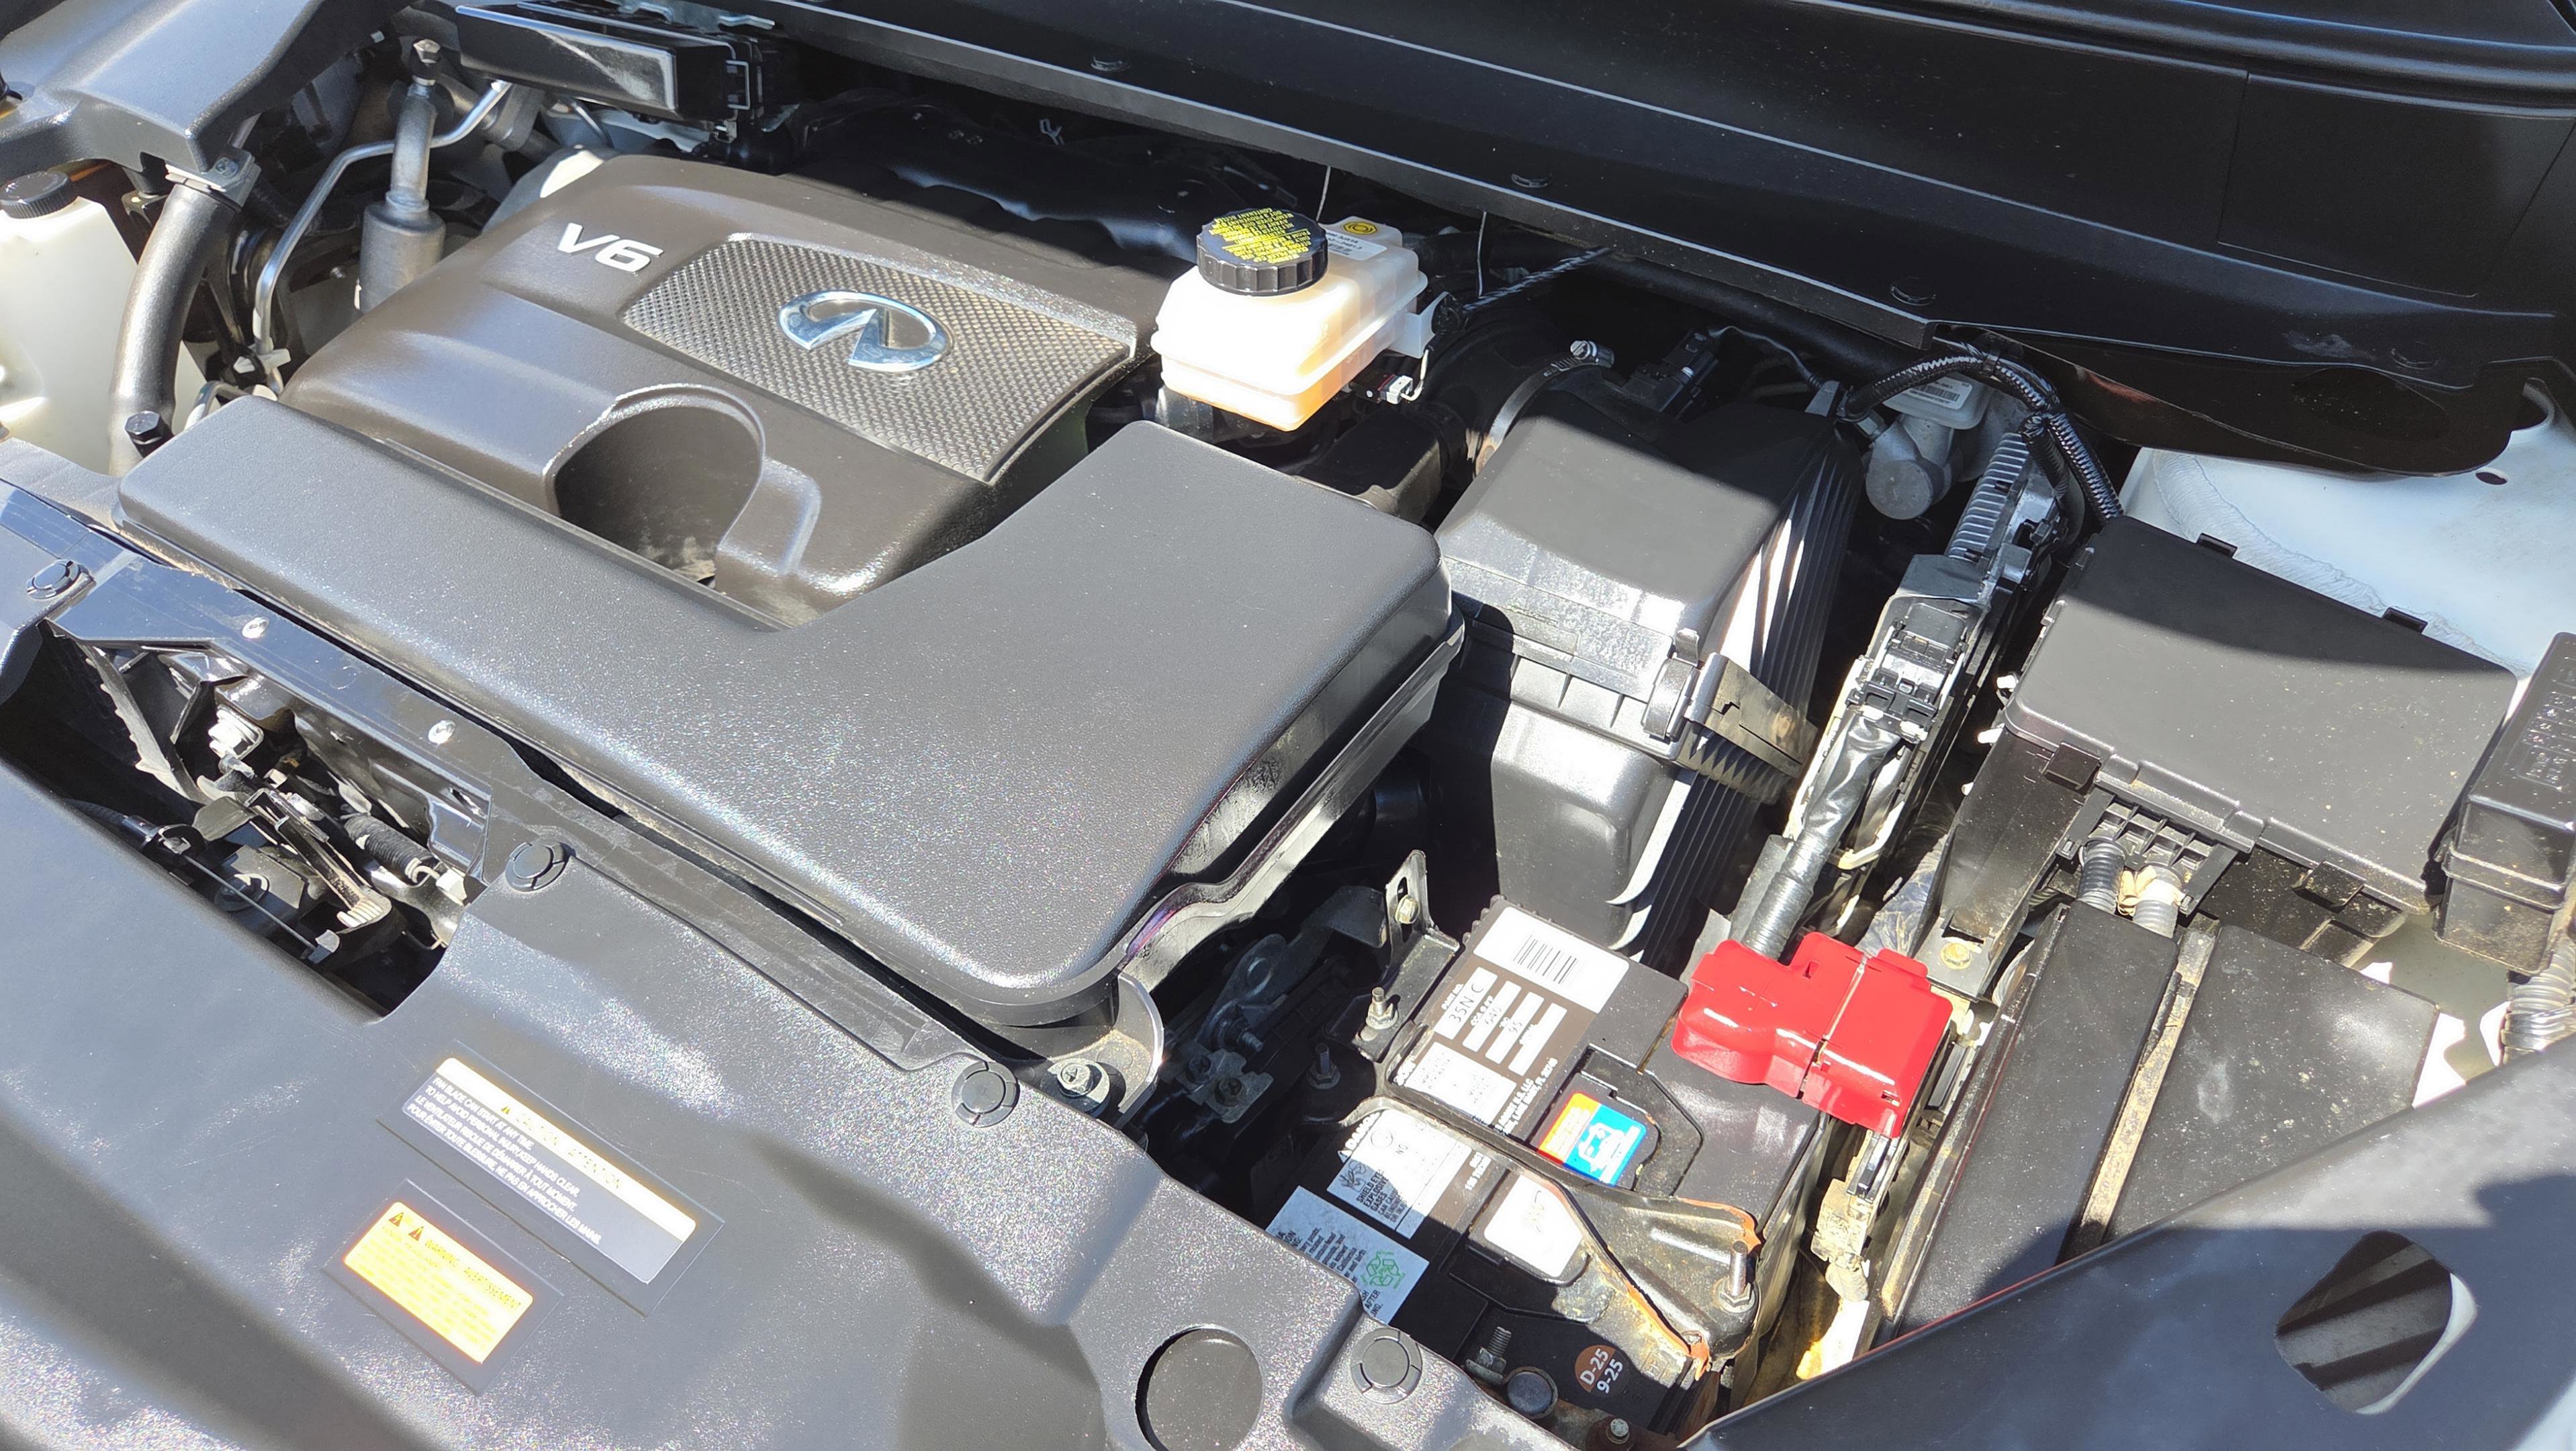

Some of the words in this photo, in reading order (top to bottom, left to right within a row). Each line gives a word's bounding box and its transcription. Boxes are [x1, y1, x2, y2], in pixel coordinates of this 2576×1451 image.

[557, 222, 664, 273] V6
[431, 1077, 448, 1090] FAN
[443, 1085, 467, 1103] BLADE
[463, 1098, 481, 1112] CAN
[476, 1107, 500, 1125] START
[502, 1125, 520, 1139] ANY
[422, 1100, 463, 1130] VENTILATEUR
[528, 1175, 550, 1191] TOUT
[424, 1085, 437, 1096] TO
[432, 1091, 453, 1107] HELP
[447, 1102, 470, 1119] AVOID
[533, 1161, 560, 1182] HANDS
[555, 1177, 582, 1197] CLEAR.
[1344, 1106, 1381, 1153] DANGE
[406, 1103, 428, 1120] POUR
[443, 1129, 467, 1147] TOUTE
[504, 1172, 521, 1186] PAS
[525, 1188, 569, 1220] APPROCHER
[563, 1215, 582, 1229] LES
[1355, 1180, 1375, 1204] SHIELD
[1362, 1174, 1389, 1208] EXPLOSIVE
[1369, 1190, 1388, 1213] GASES
[1377, 1202, 1389, 1216] CAN
[1363, 1288, 1381, 1310] AFTER
[1577, 1346, 1611, 1386] D-25
[1594, 1357, 1626, 1395] 9-25
